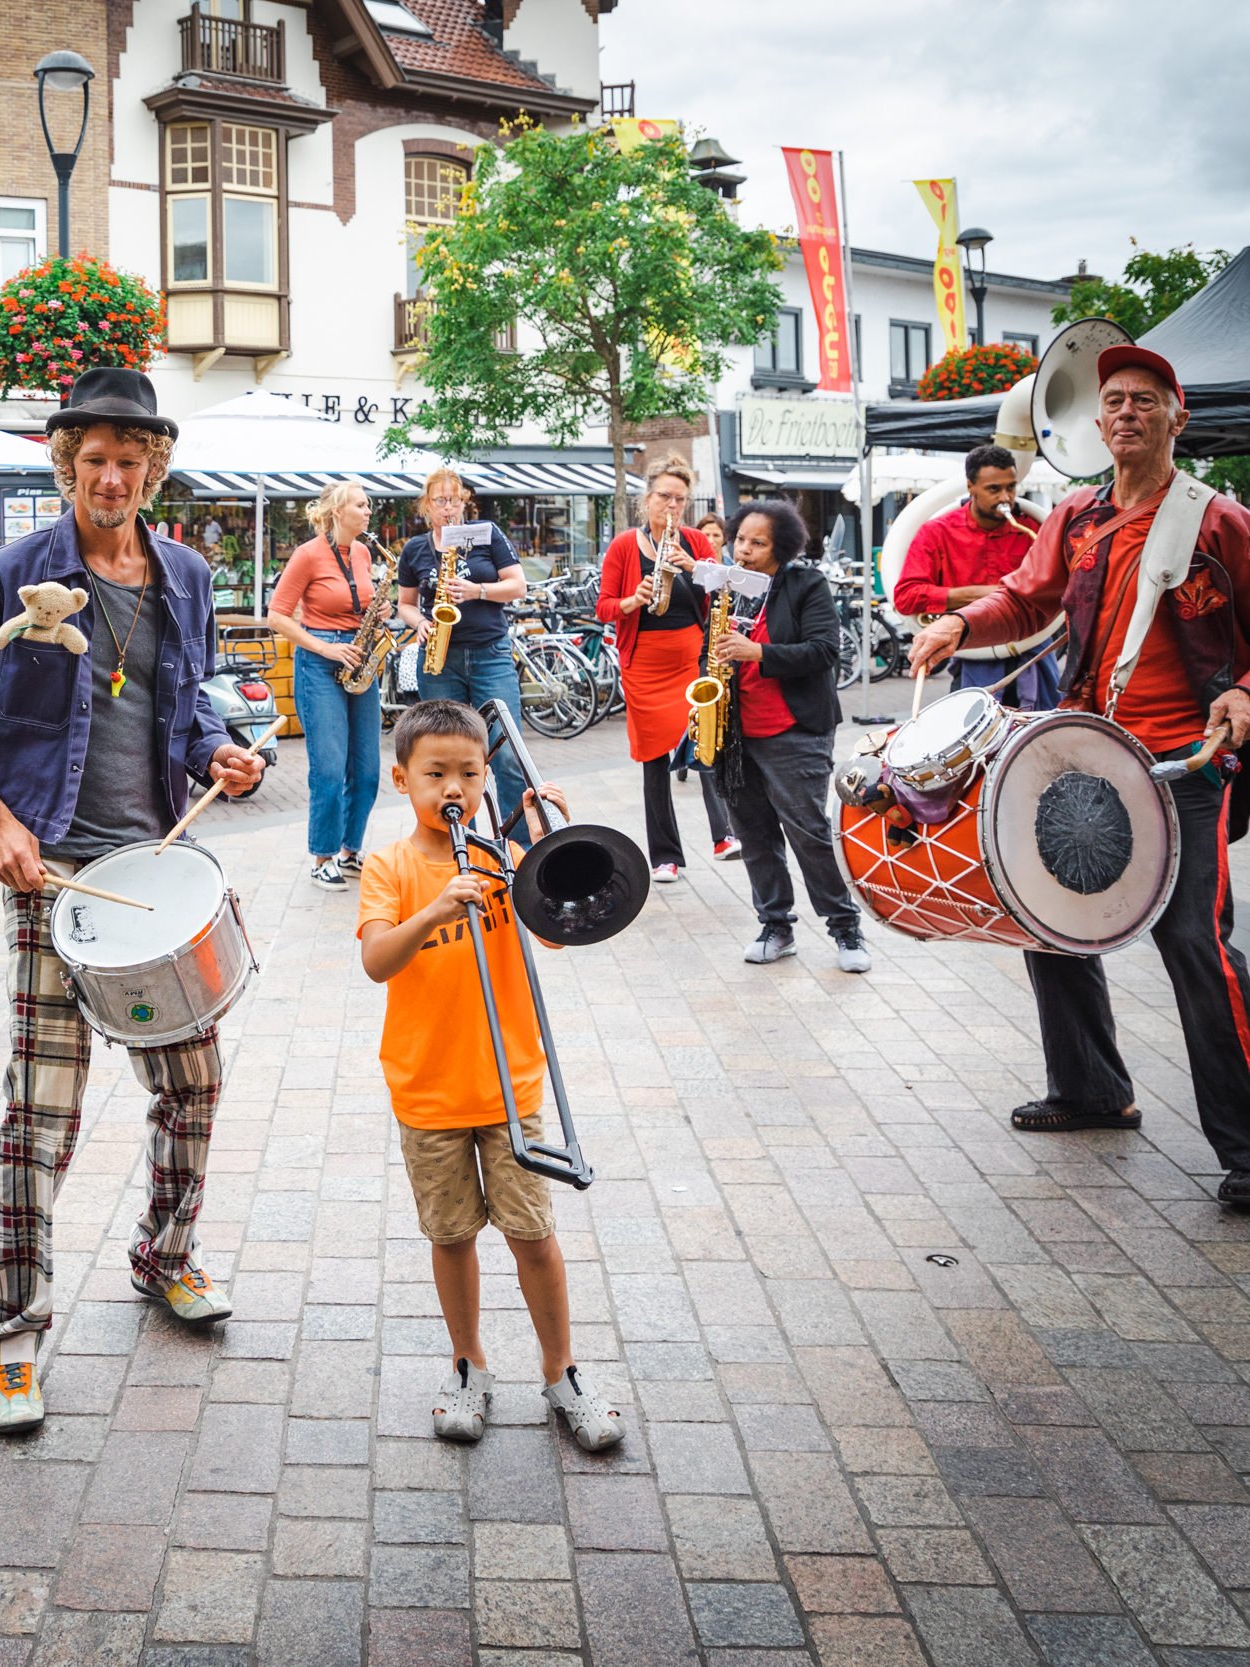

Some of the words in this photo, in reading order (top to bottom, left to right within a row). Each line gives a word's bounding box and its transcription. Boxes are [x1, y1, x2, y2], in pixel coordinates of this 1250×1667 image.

[354, 396, 378, 424] &
[747, 407, 773, 446] De
[16, 488, 42, 496] Pino
